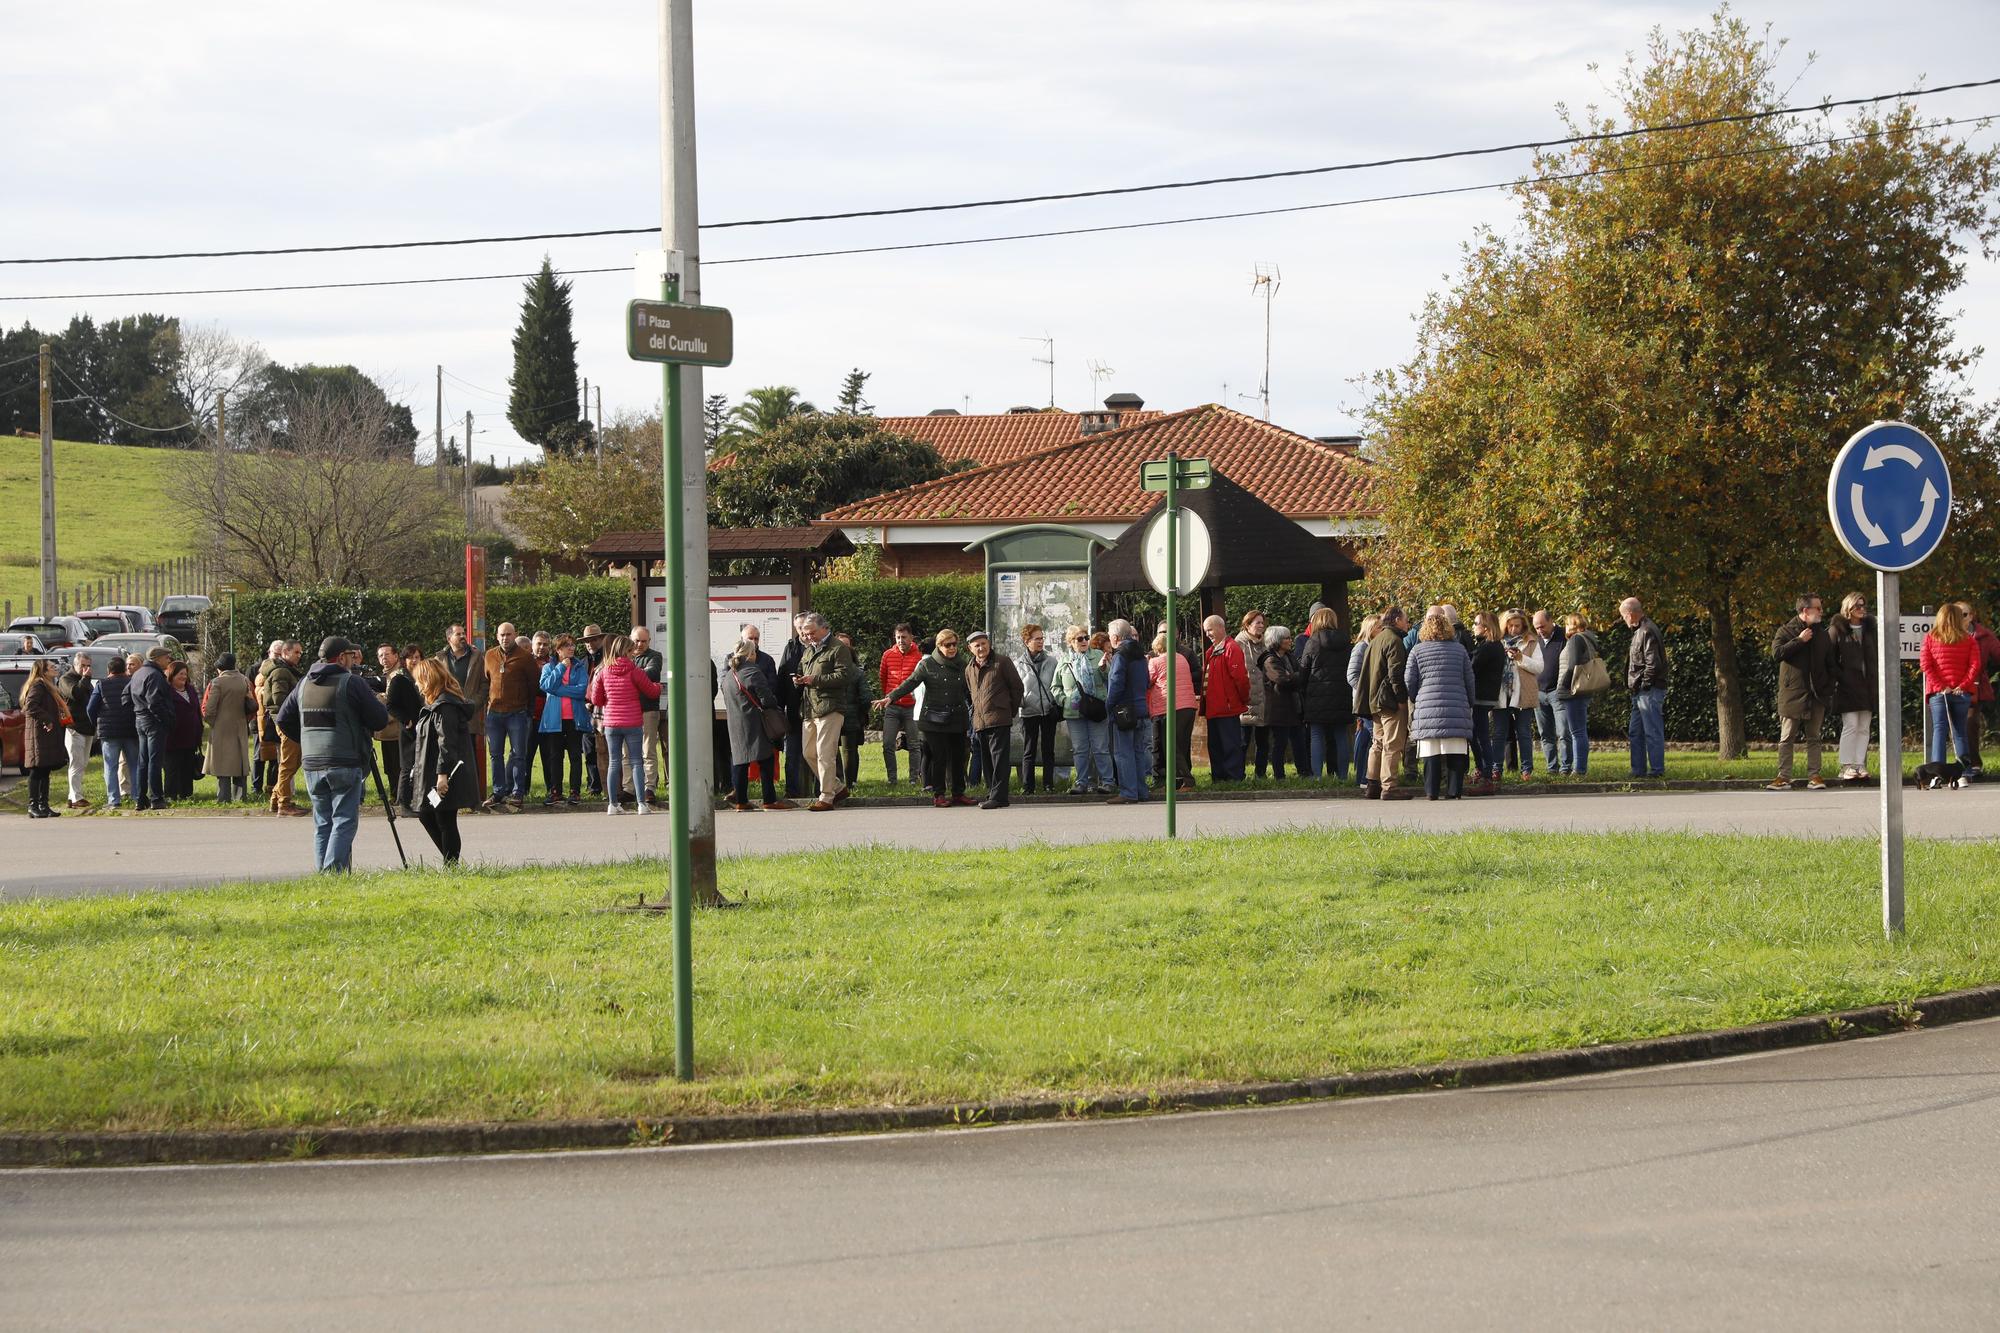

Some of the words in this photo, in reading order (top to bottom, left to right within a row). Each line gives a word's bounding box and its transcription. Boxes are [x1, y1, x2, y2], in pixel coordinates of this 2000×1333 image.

[649, 315, 671, 328] Plaza
[649, 333, 666, 350] del
[669, 335, 707, 353] Curullu
[1900, 624, 1905, 632] E
[1912, 623, 1933, 632] GO
